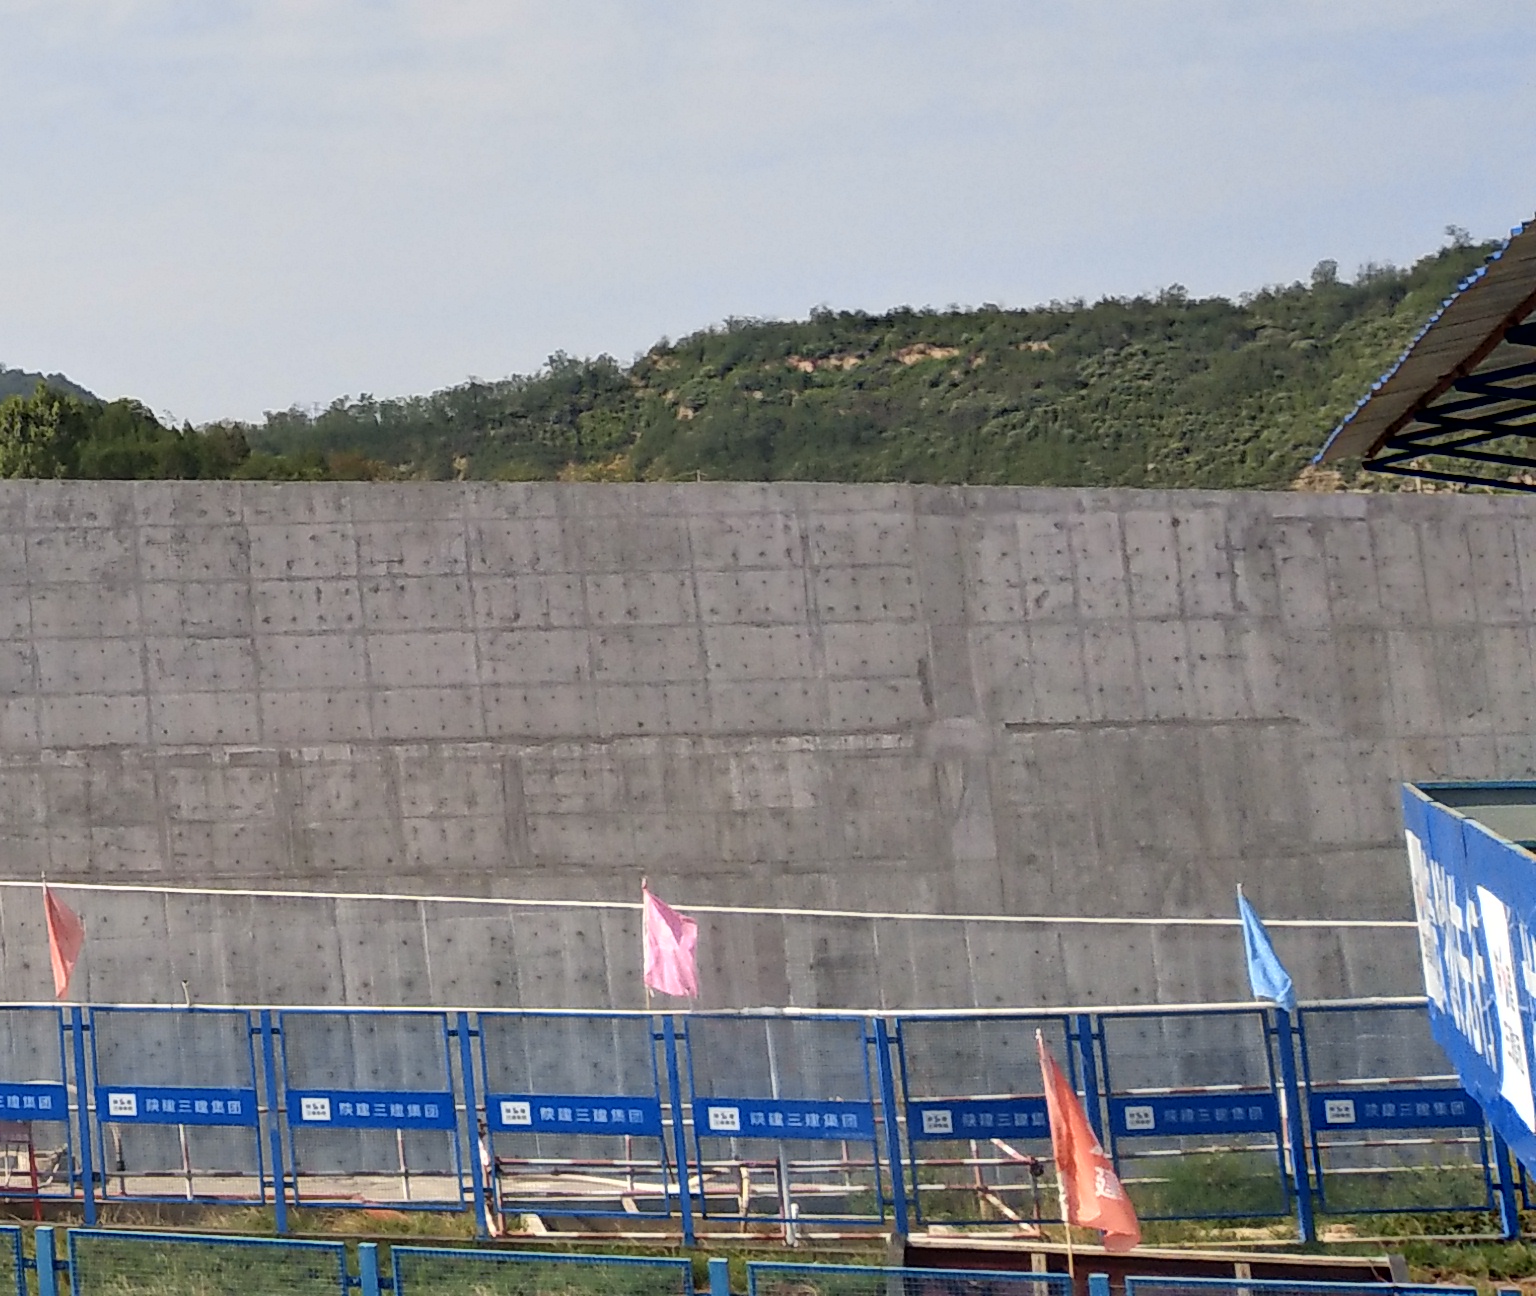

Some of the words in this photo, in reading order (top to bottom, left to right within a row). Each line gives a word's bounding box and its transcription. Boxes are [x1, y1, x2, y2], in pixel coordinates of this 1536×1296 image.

[146, 1098, 241, 1115] 陕建三建集团
[339, 1102, 439, 1118] 陕建三建集团
[1366, 1101, 1465, 1117] 陕建三建集团
[540, 1107, 644, 1124] 陕建三建集团
[750, 1112, 858, 1128] 陕建三建集团
